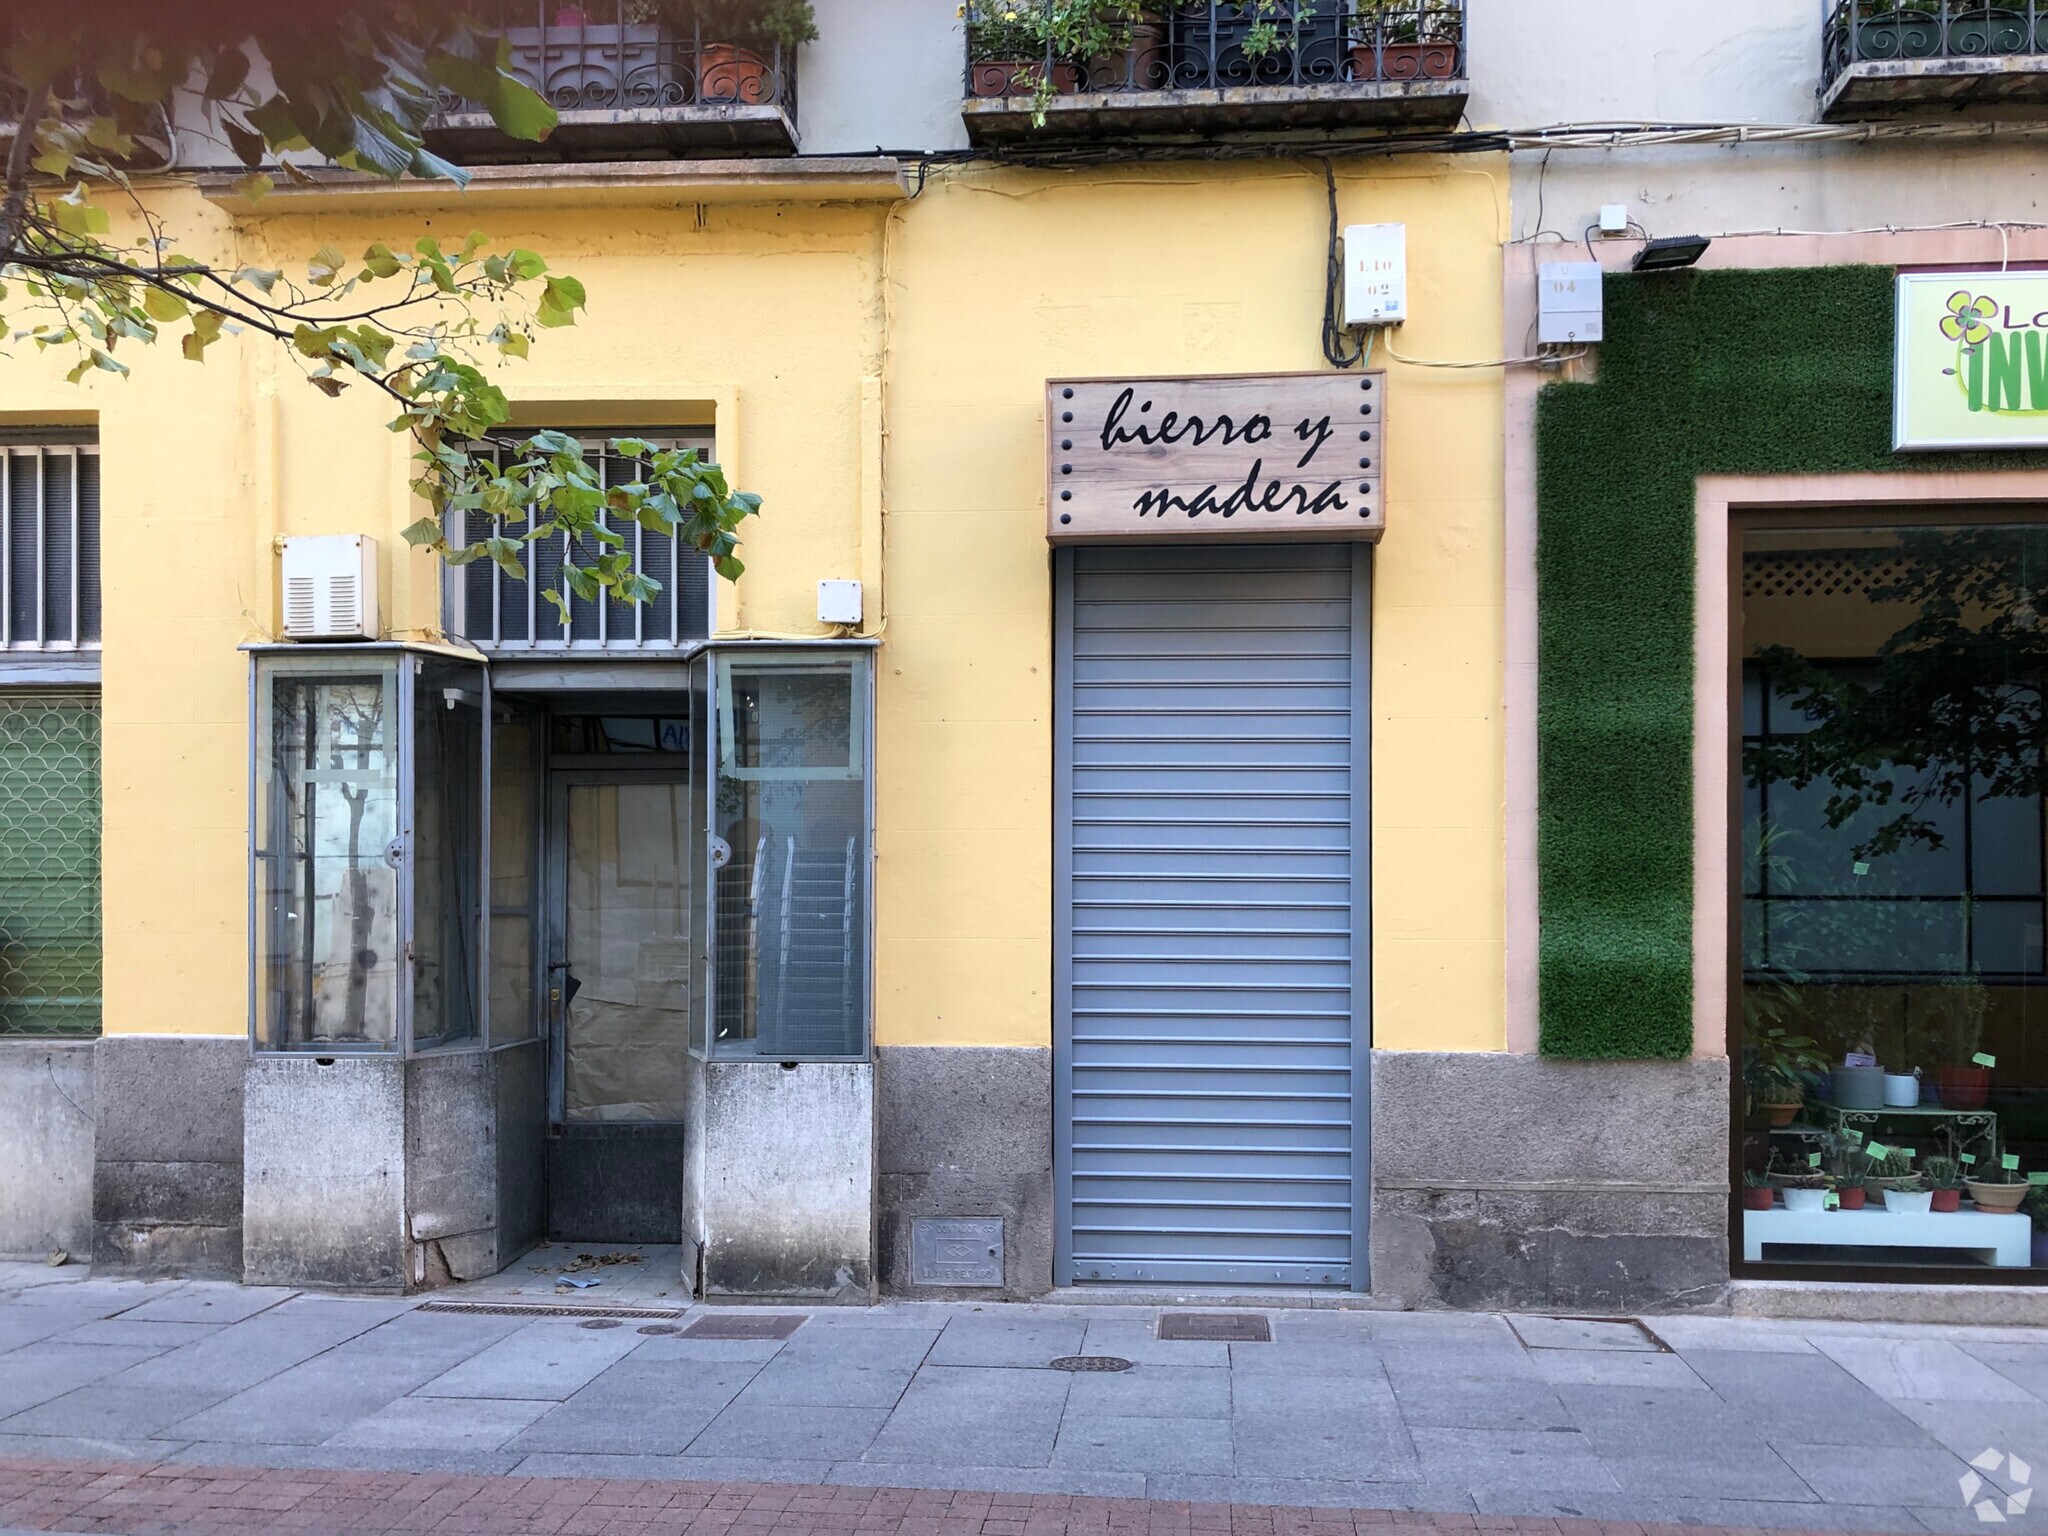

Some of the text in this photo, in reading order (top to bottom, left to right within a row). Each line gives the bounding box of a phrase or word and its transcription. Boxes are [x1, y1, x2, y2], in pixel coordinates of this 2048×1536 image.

[1100, 387, 1334, 469] hierro y
[1133, 458, 1349, 518] madera
